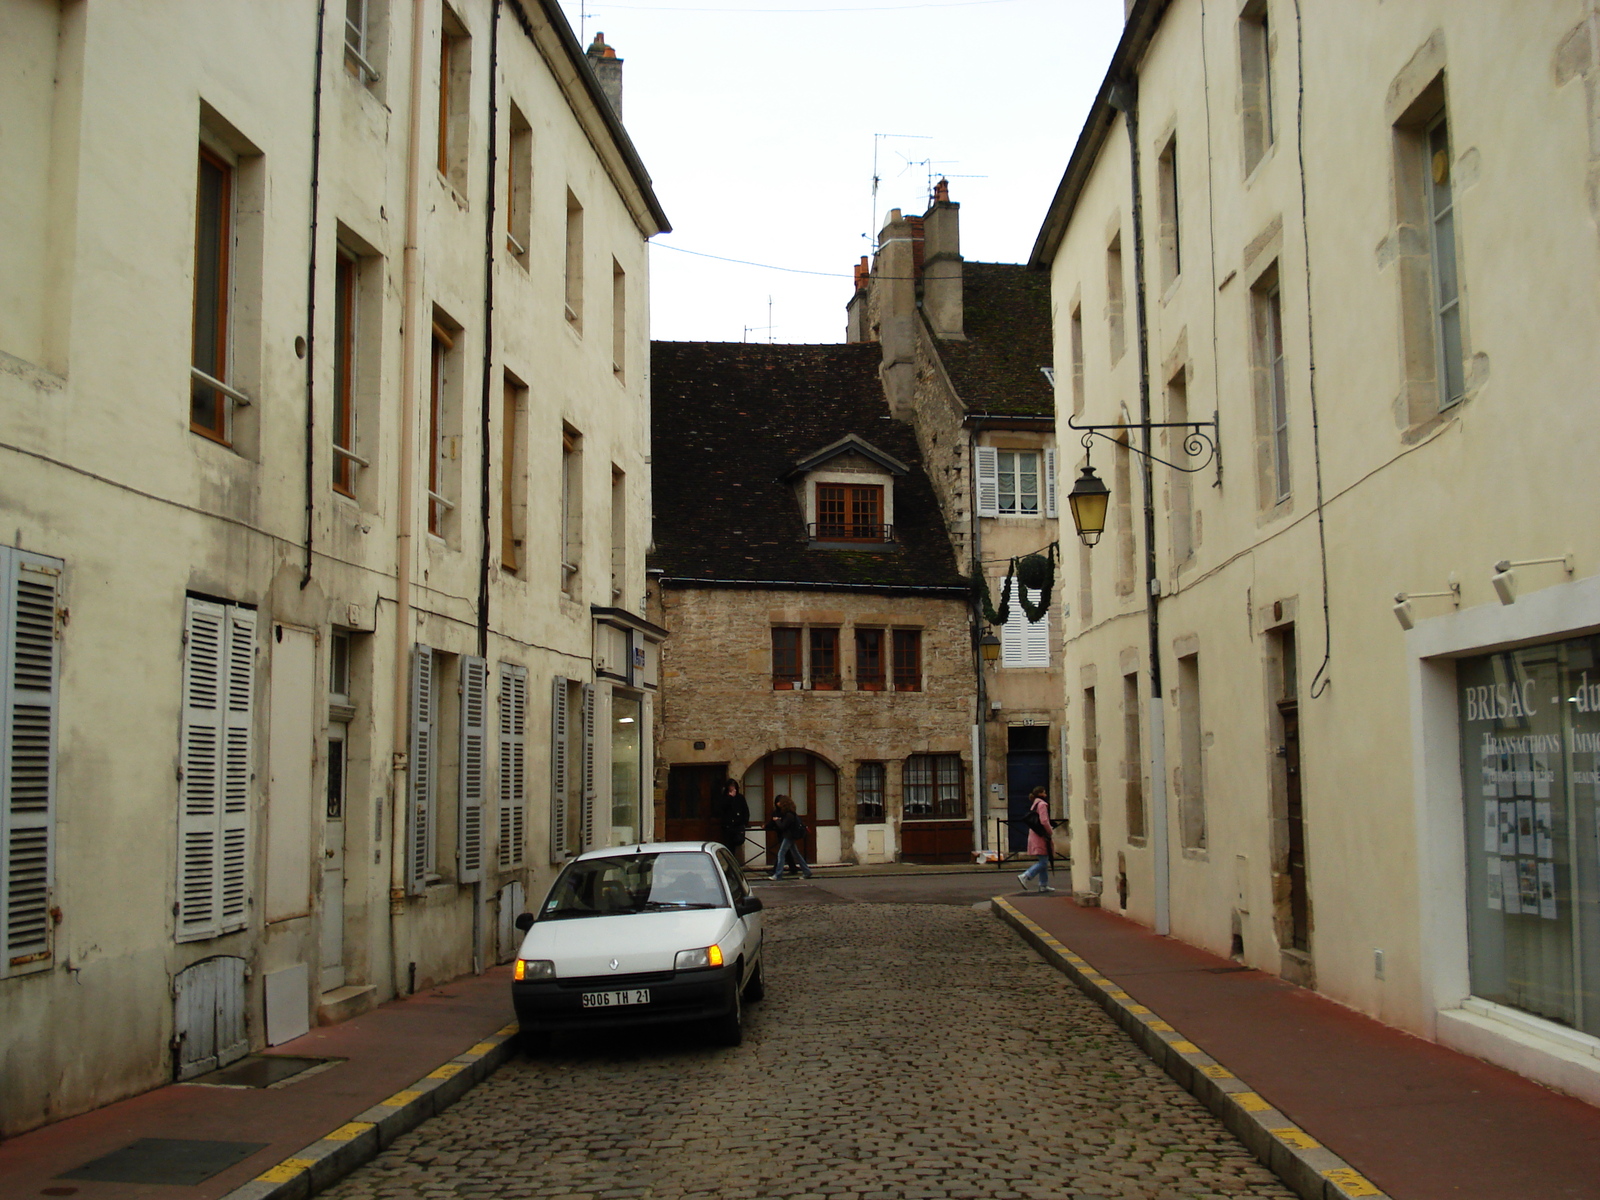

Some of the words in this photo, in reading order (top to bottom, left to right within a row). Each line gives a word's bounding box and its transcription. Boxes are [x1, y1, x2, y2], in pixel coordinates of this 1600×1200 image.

[1465, 679, 1537, 721] BRISAC
[1483, 732, 1560, 754] TRANSACTIONS
[583, 993, 610, 1007] 9006
[615, 991, 629, 1005] TH
[636, 989, 649, 1003] 21
